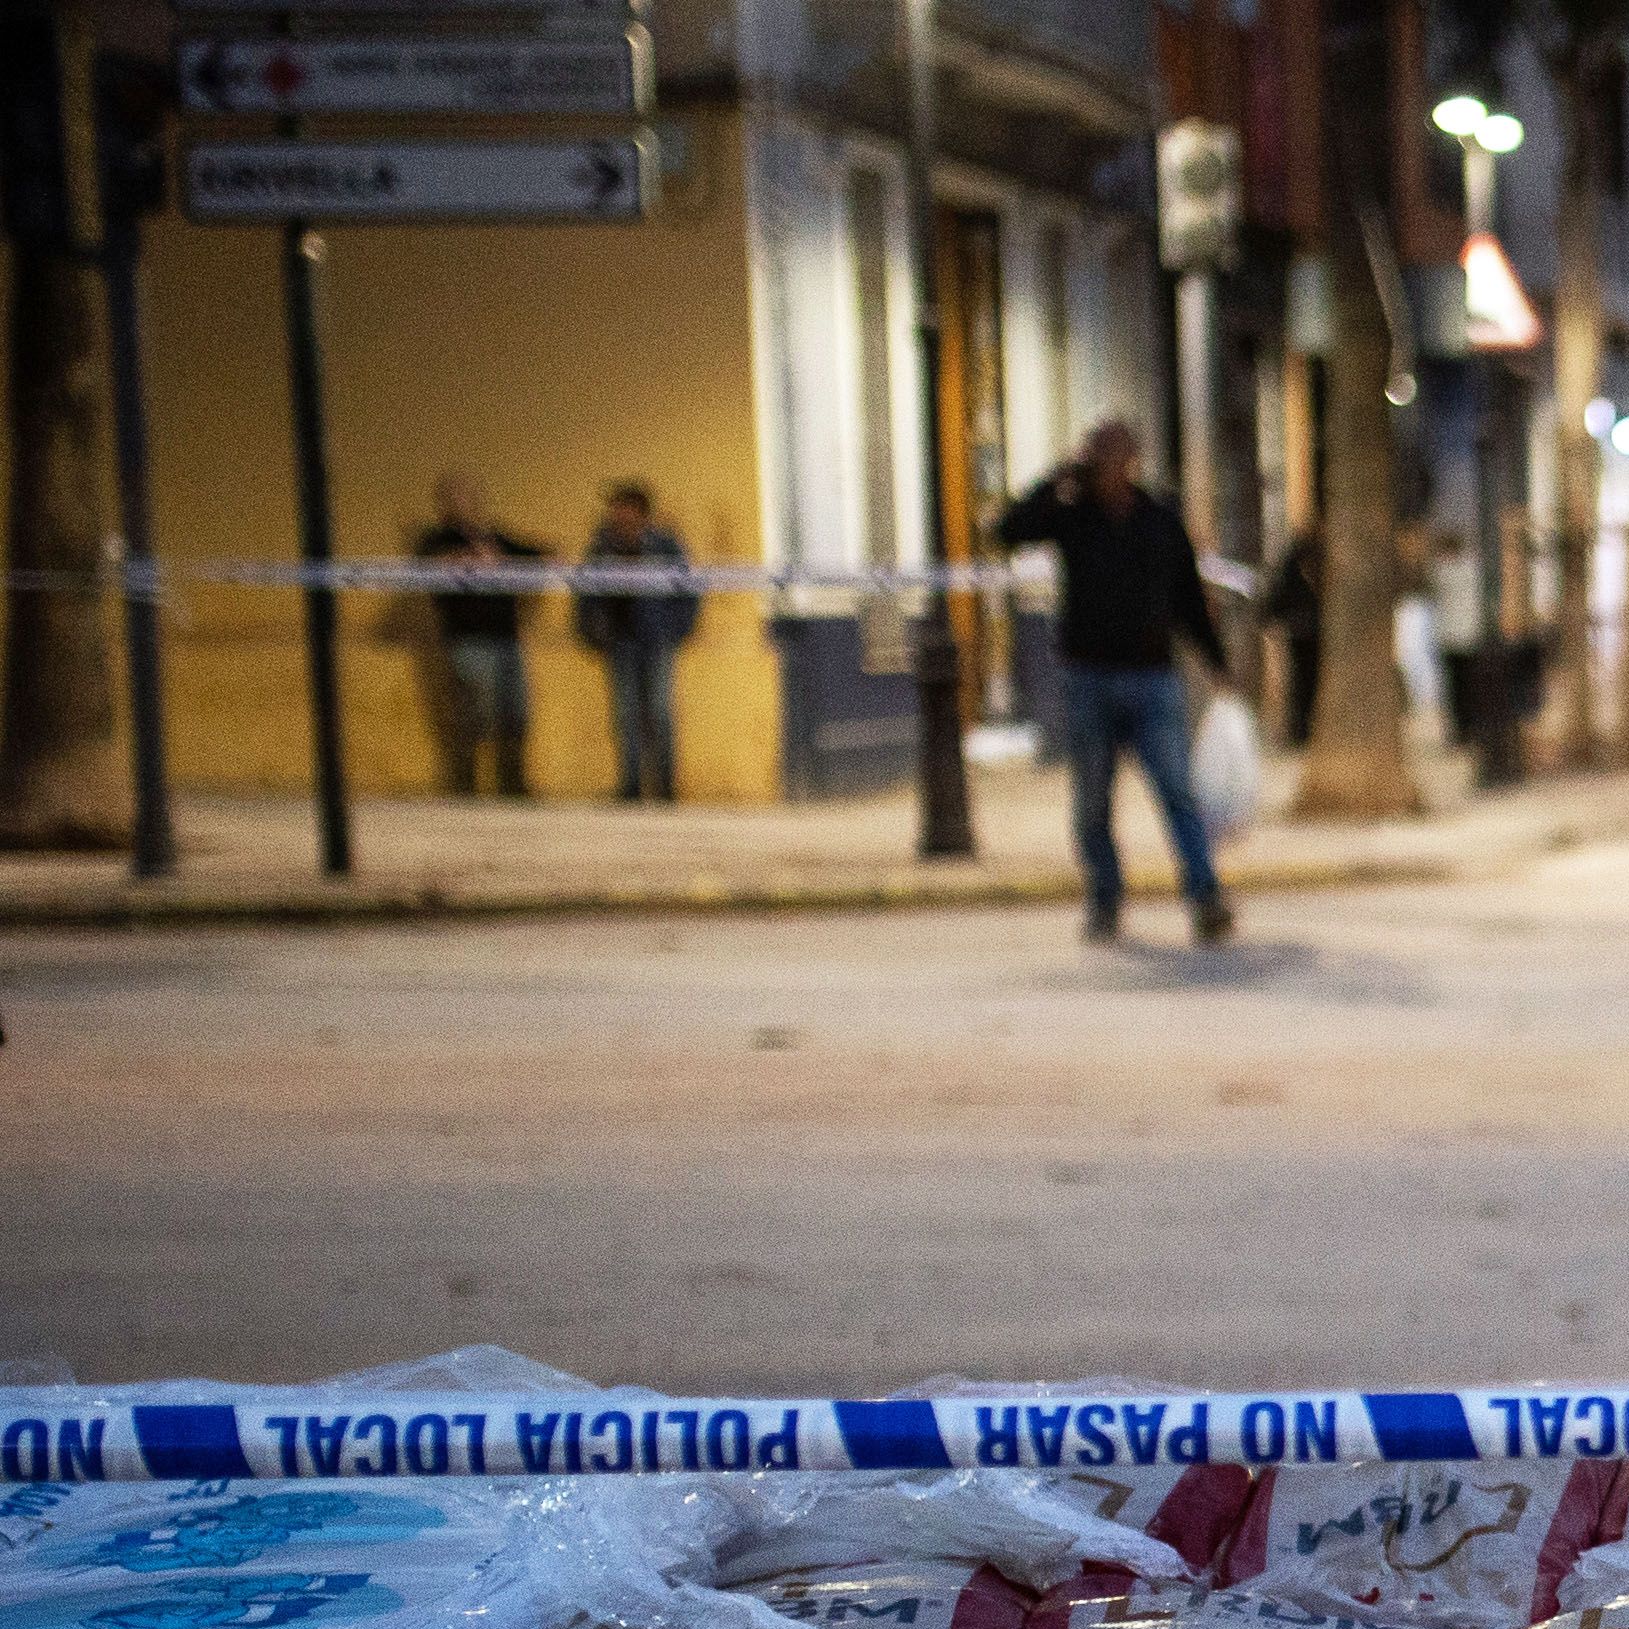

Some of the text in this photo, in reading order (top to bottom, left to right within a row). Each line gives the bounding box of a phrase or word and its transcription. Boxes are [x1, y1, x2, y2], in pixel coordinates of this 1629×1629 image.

[0, 1415, 107, 1484] NO
[264, 1413, 487, 1478] LOCAL
[515, 1408, 799, 1476] POLICIA
[976, 1403, 1207, 1469] PASAR
[1240, 1401, 1338, 1463] NO
[768, 1597, 921, 1624] BM
